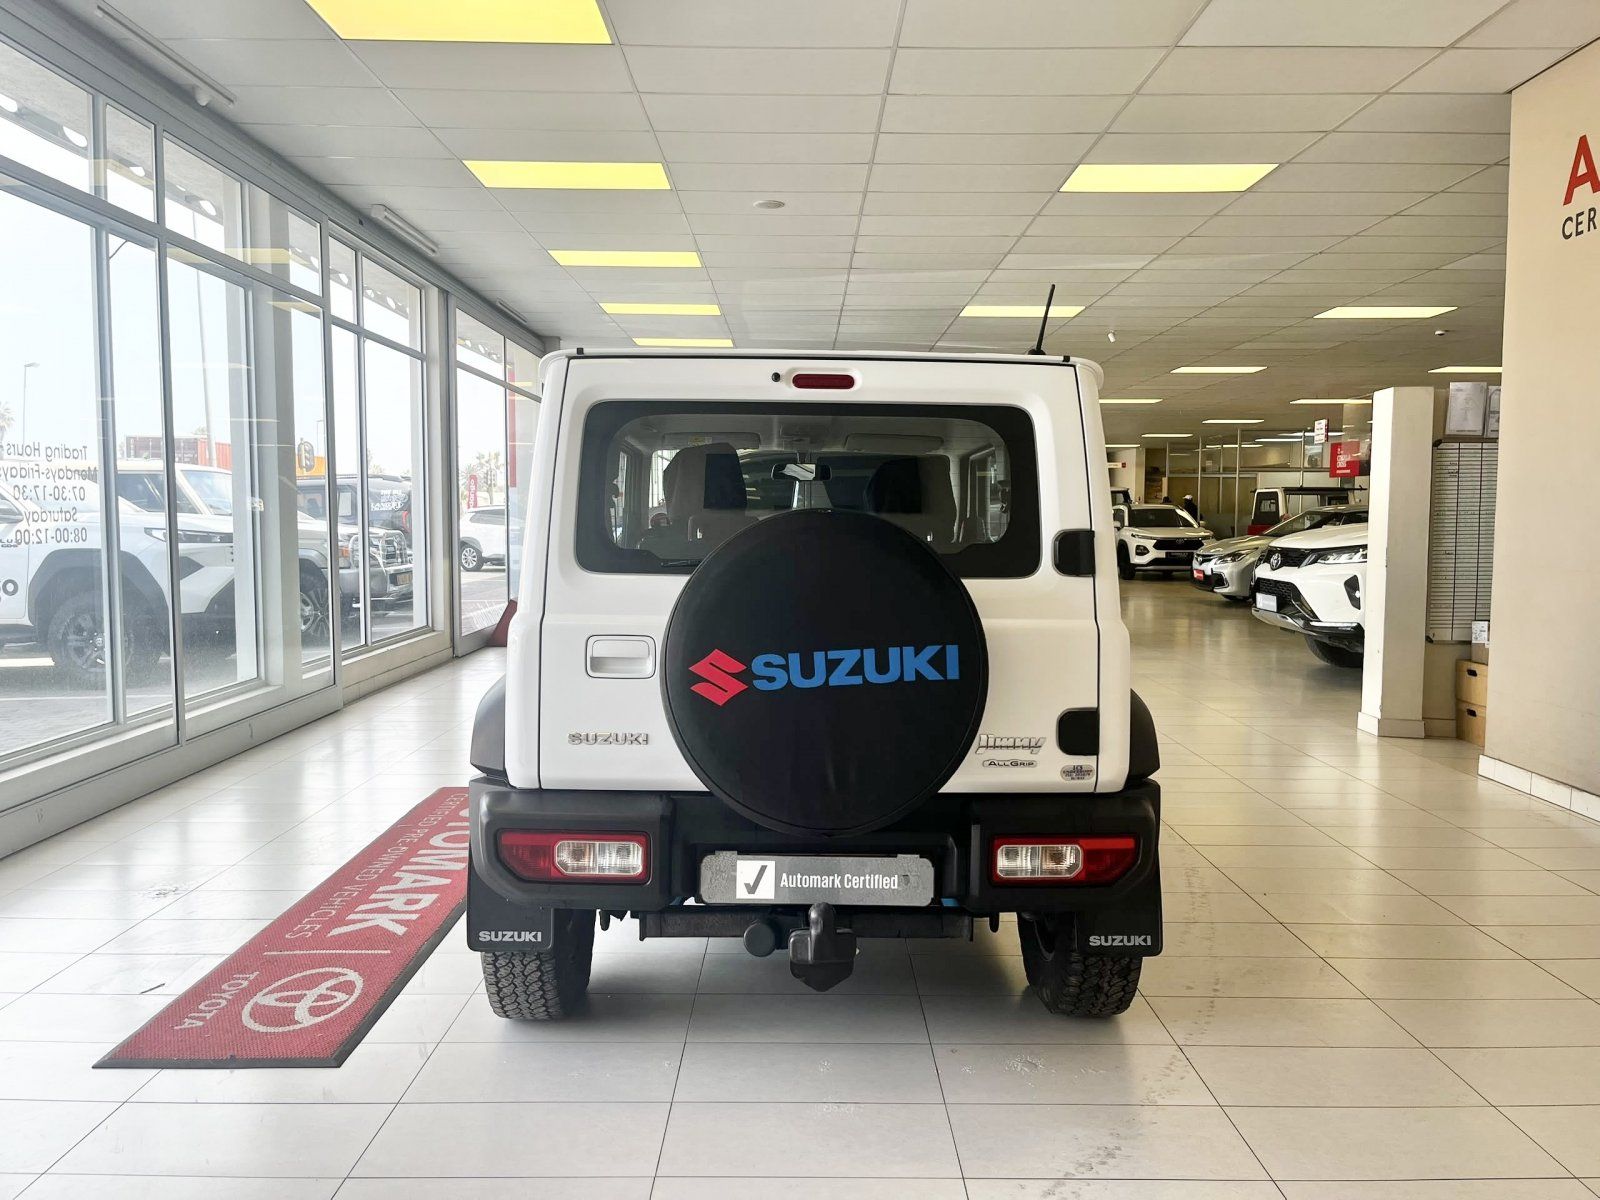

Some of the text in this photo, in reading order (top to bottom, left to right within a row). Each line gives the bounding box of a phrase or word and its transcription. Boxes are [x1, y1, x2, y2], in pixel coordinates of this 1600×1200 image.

[1562, 207, 1597, 239] CER
[752, 645, 960, 692] SUZUKI
[568, 732, 649, 746] SUZUKI
[975, 734, 1046, 754] Jimny
[285, 793, 469, 940] CERTIFIED PRE-OWNED VEHICLES
[780, 872, 898, 890] Automark Certified
[479, 930, 541, 941] SUZUKI
[1089, 935, 1152, 946] SUZUKI
[173, 970, 261, 1030] TOYOTA
